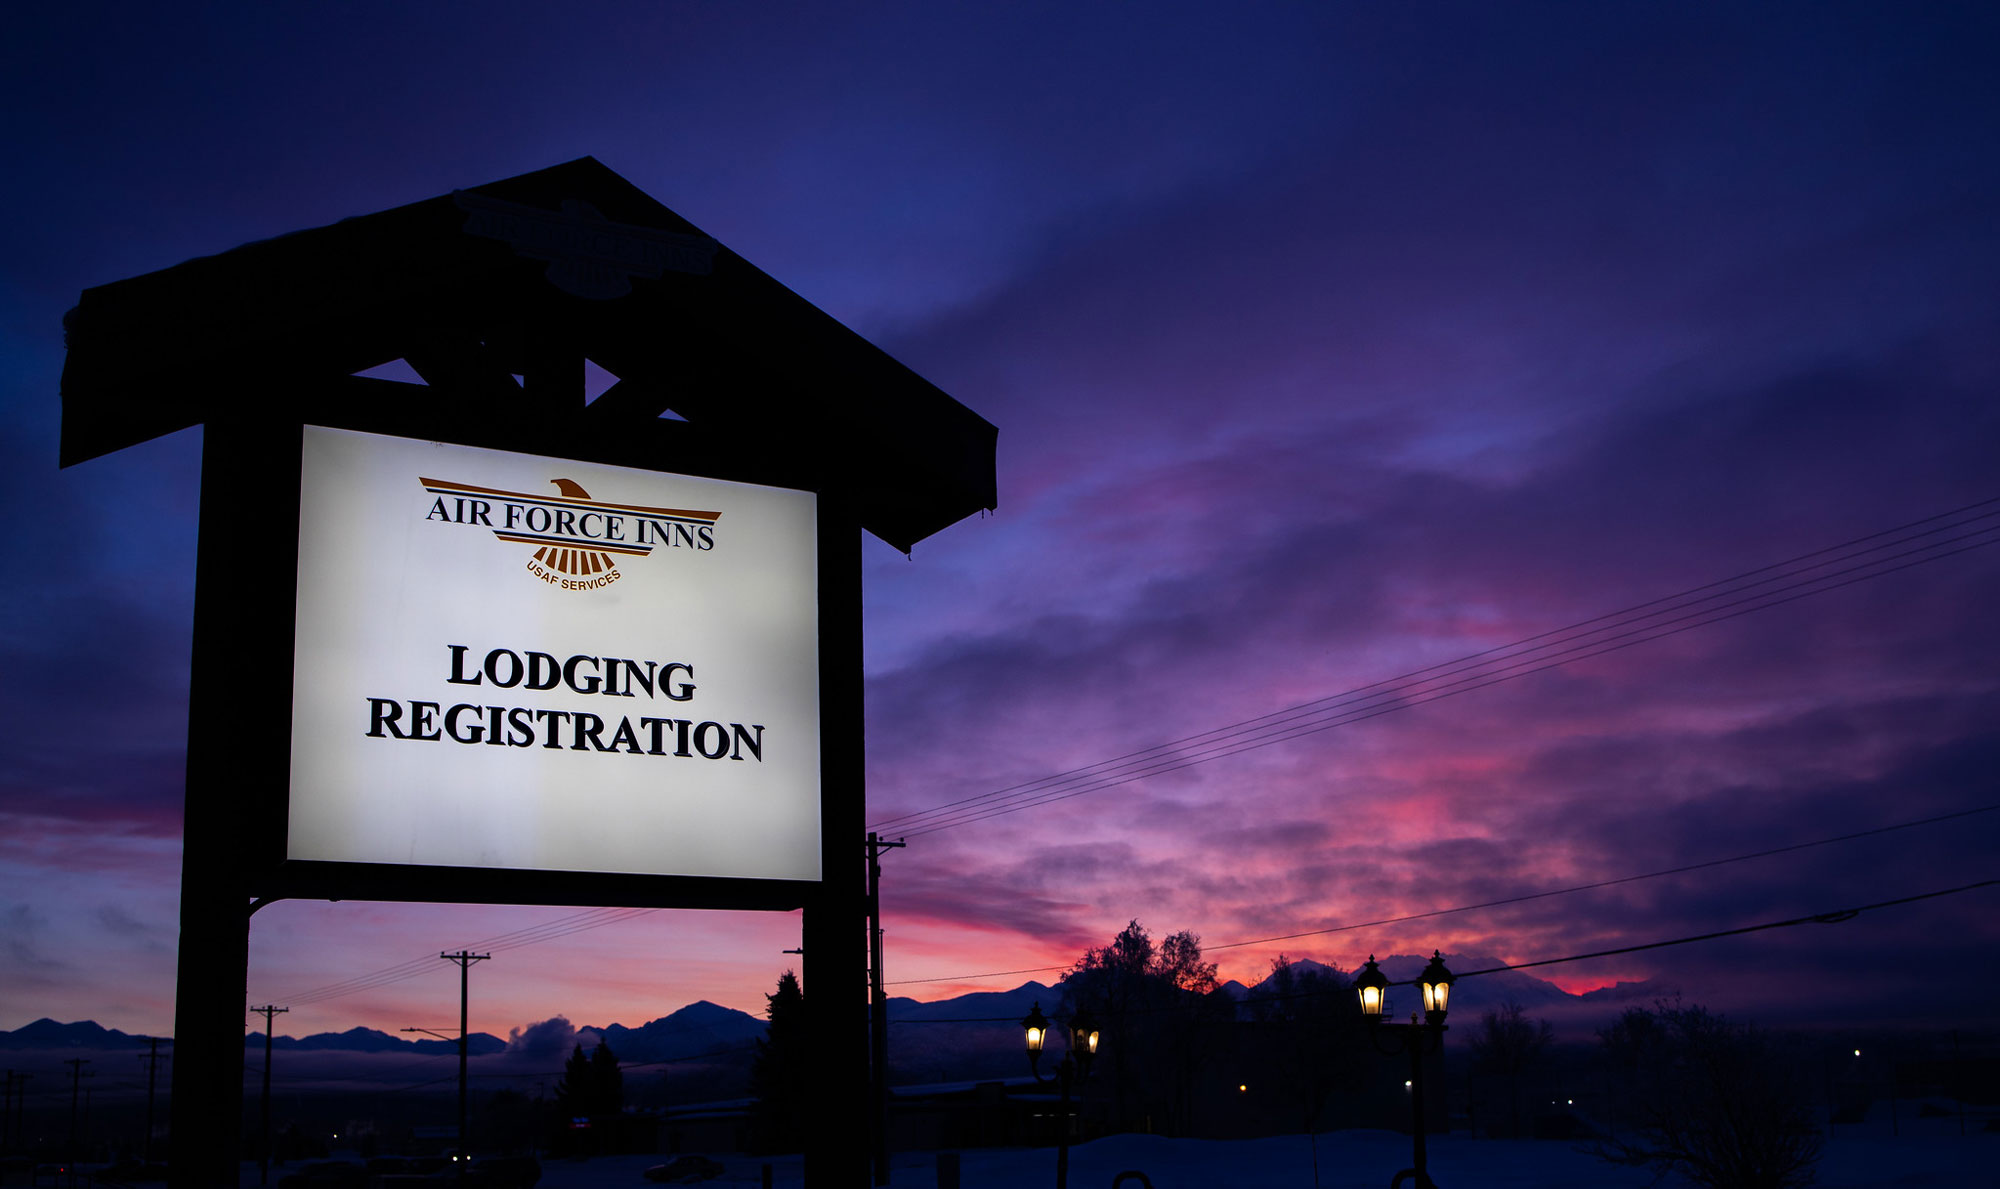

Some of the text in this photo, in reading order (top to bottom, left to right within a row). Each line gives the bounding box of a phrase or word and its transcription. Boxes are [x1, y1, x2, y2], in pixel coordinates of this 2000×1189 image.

[426, 496, 715, 551] AIR FORCE INNS
[526, 560, 621, 590] USAF SERVICES
[447, 645, 696, 701] LODGING
[366, 698, 765, 762] REGISTRATION
